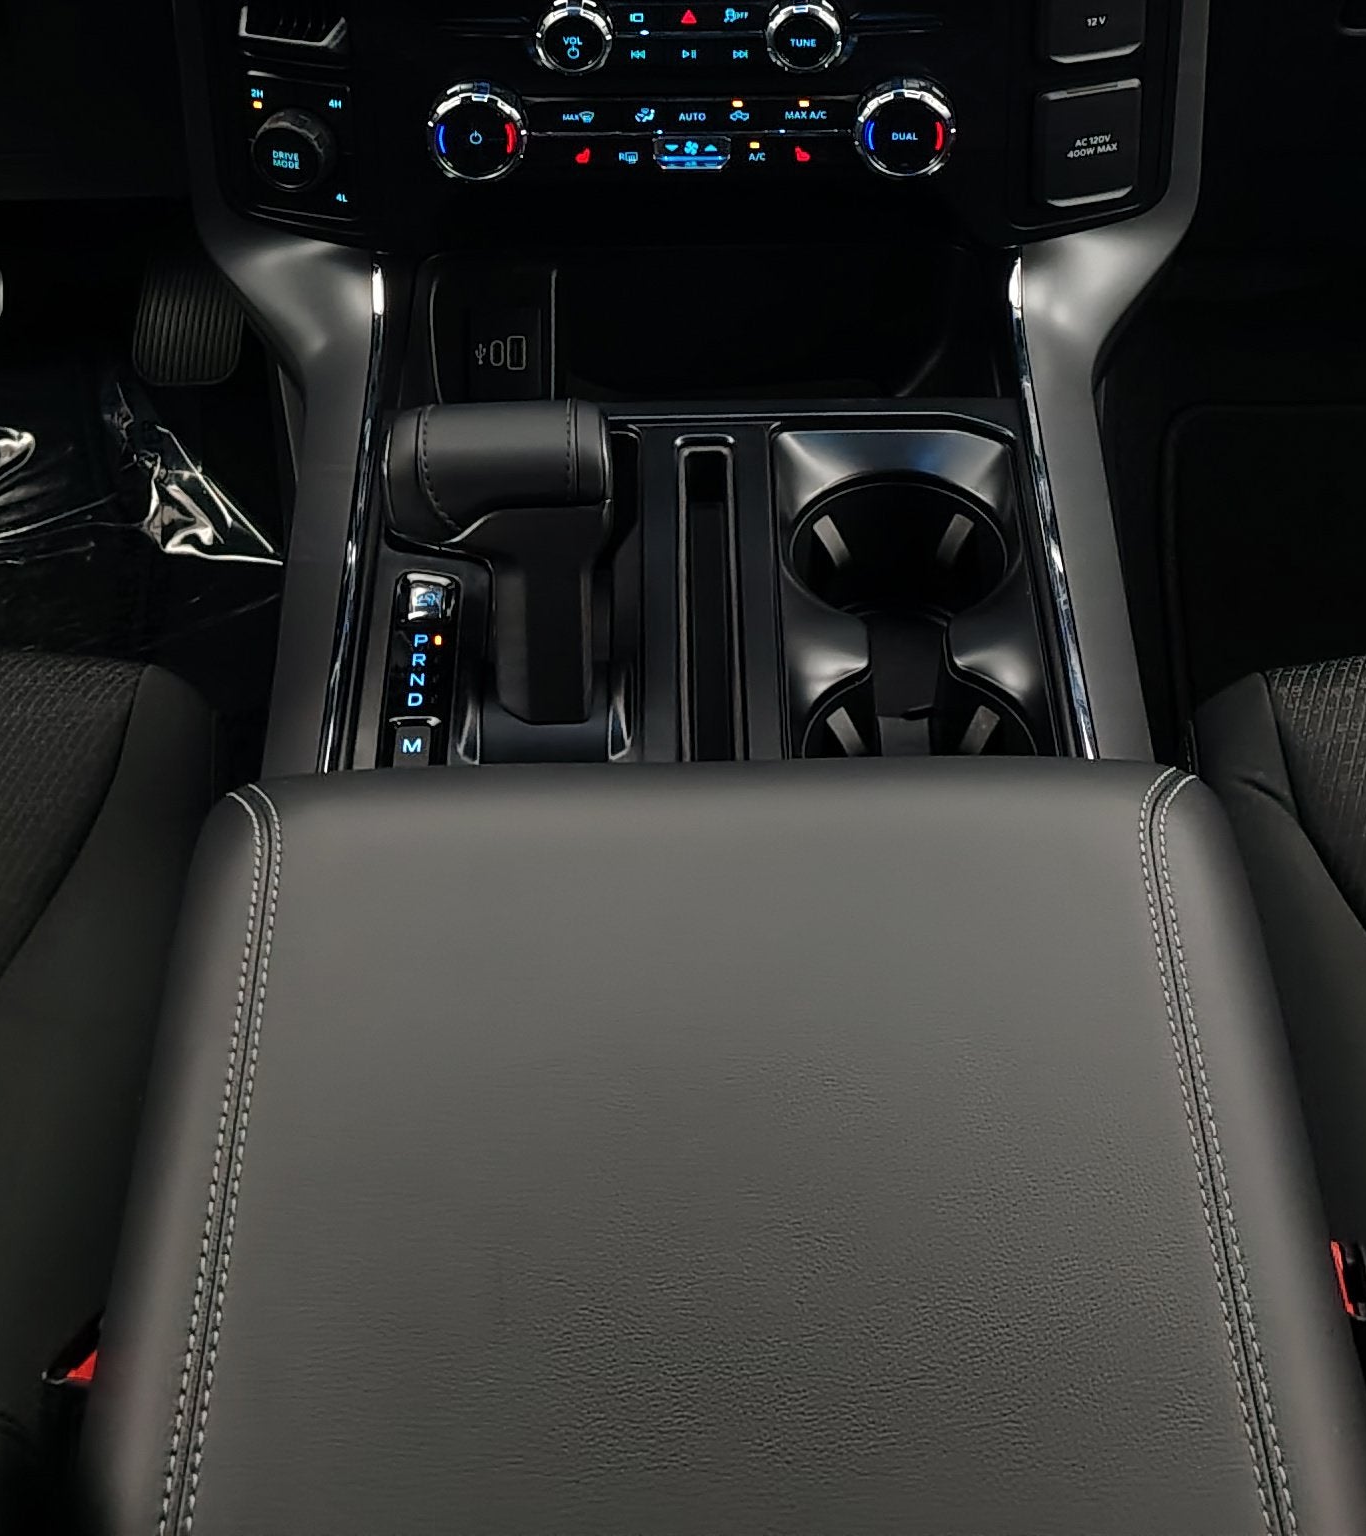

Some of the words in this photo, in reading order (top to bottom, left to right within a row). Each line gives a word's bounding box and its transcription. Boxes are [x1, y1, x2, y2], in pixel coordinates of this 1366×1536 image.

[1087, 17, 1098, 27] 12
[563, 36, 583, 46] VOL
[790, 38, 817, 48] TUNE
[251, 88, 264, 99] 2H
[328, 99, 342, 109] 4H
[678, 112, 706, 122] AUTO
[785, 111, 808, 121] MAX
[809, 110, 828, 121] A/C
[891, 132, 919, 142] DUAL
[1074, 138, 1088, 148] AC
[272, 149, 299, 162] DRIVE
[1067, 147, 1096, 159] 400W
[1097, 142, 1119, 155] MAX
[748, 152, 766, 162] A/C
[272, 159, 300, 170] MODE
[335, 192, 348, 203] 4L
[414, 633, 429, 648] P
[412, 653, 427, 667] R
[409, 673, 425, 687] N
[407, 693, 423, 707] D
[402, 738, 422, 753] M
